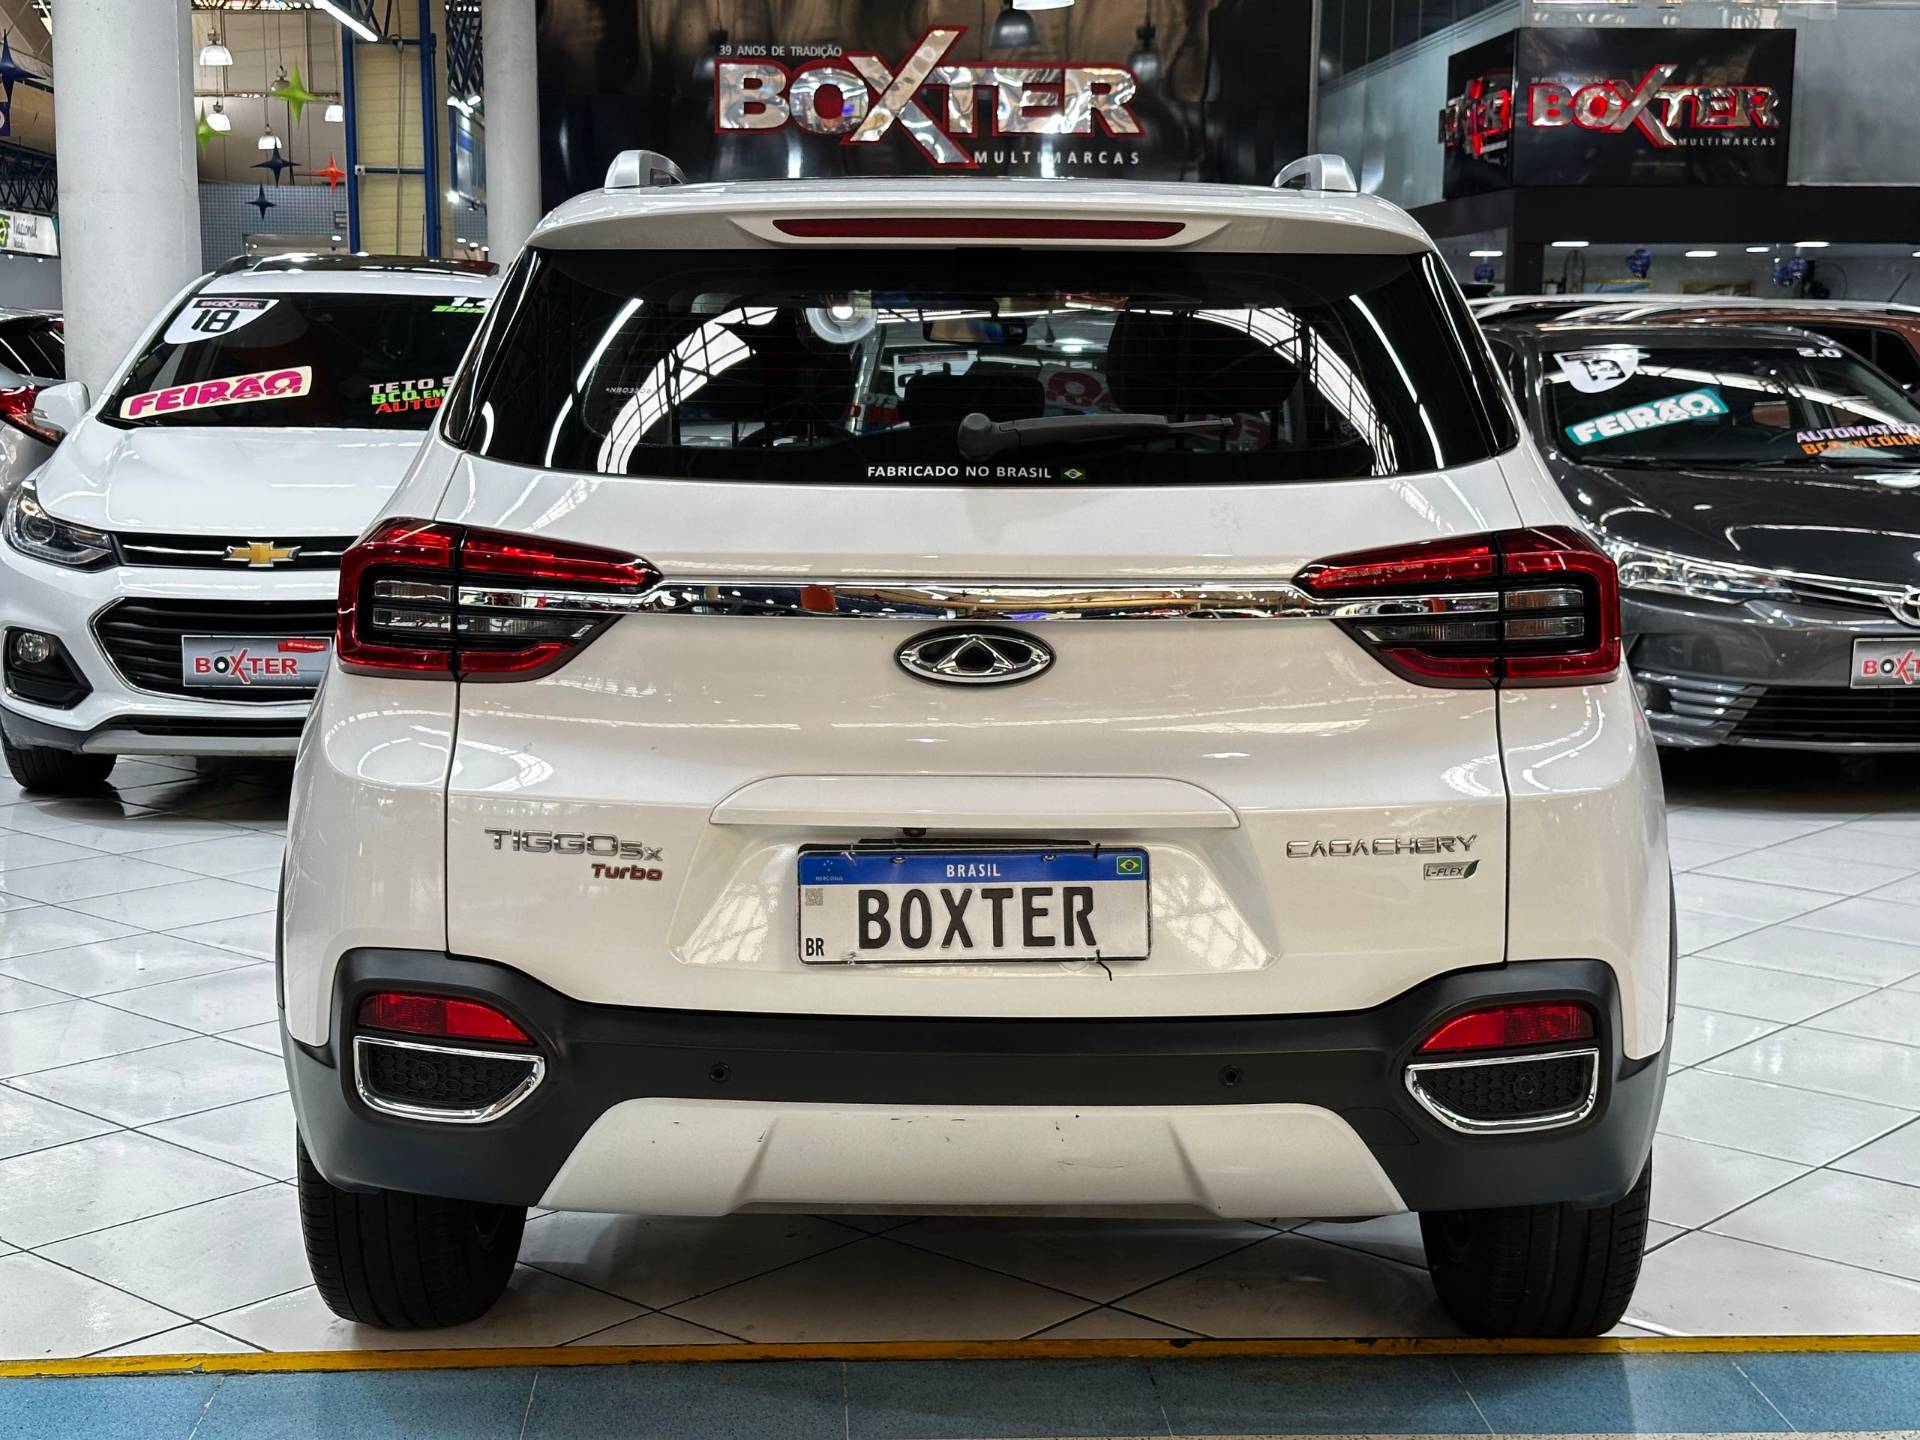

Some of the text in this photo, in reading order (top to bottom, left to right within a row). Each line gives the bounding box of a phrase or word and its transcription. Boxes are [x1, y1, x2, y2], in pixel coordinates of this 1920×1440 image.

[720, 44, 842, 58] 39 ANOS DE TRADIÇÃO
[714, 25, 1146, 169] BOXTER
[1527, 63, 1780, 148] BOXTER
[1676, 138, 1777, 147] MULTIMARCAS
[973, 151, 1140, 165] MULTIMARCAS
[191, 309, 240, 333] 18
[128, 370, 303, 416] FEIRÃO
[369, 378, 434, 395] TETO
[867, 466, 1052, 478] FABRICADO NO BRASIL
[194, 648, 300, 684] BOXTER
[591, 863, 663, 882] Turbo
[946, 863, 1001, 878] BRASIL
[858, 887, 1097, 949] BOXTER
[805, 938, 825, 956] BR
